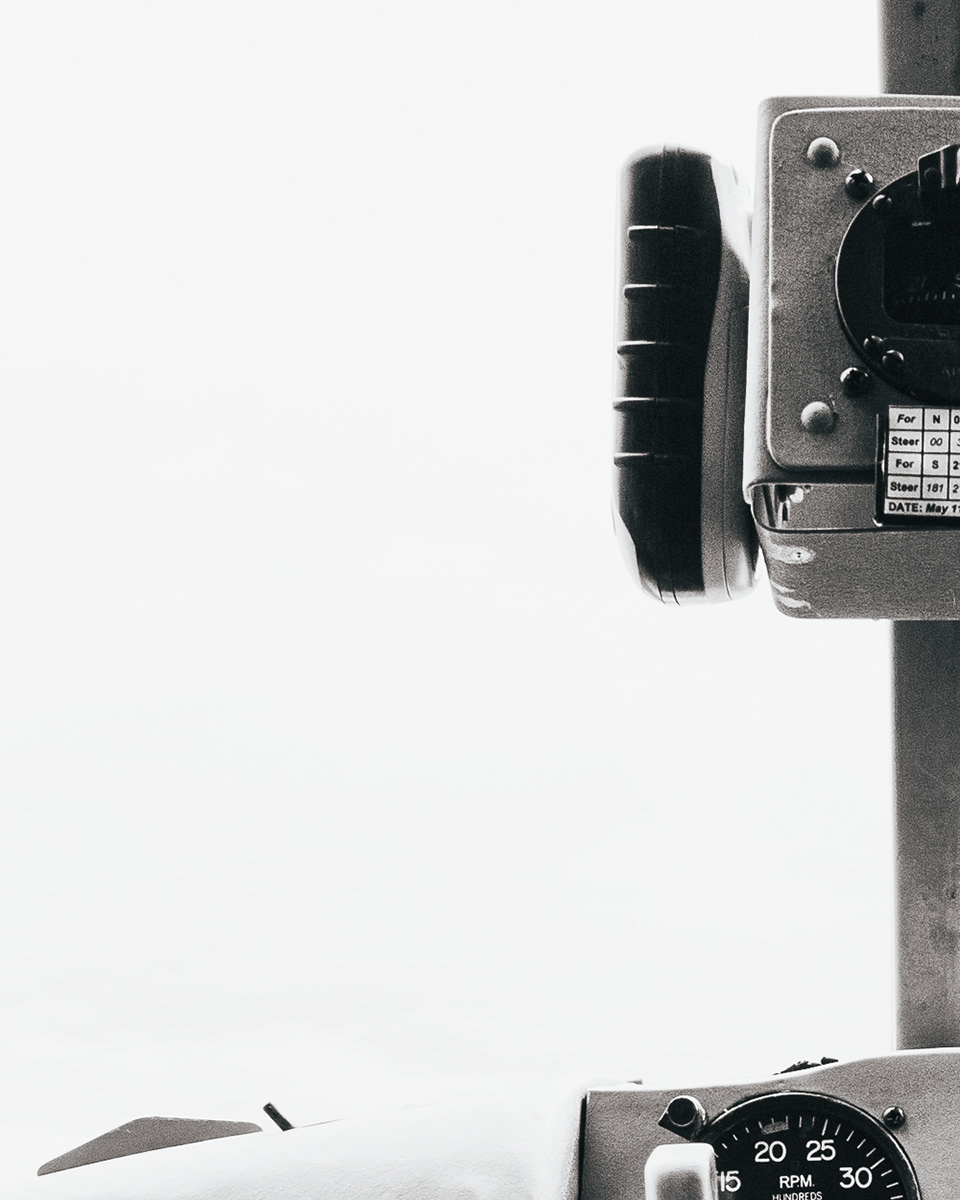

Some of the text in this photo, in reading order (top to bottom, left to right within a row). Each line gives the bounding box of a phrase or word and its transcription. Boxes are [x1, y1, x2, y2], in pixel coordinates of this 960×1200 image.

[896, 414, 915, 423] For
[932, 414, 941, 424] N
[891, 437, 919, 446] Steer
[930, 438, 943, 447] 00
[895, 459, 914, 469] For
[932, 460, 939, 469] S
[889, 482, 918, 492] Steer
[926, 483, 944, 493] 181
[888, 502, 923, 512] DATE:
[925, 504, 949, 515] May
[754, 1139, 836, 1163] 20 25
[719, 1171, 742, 1192] 15
[839, 1167, 873, 1189] 30
